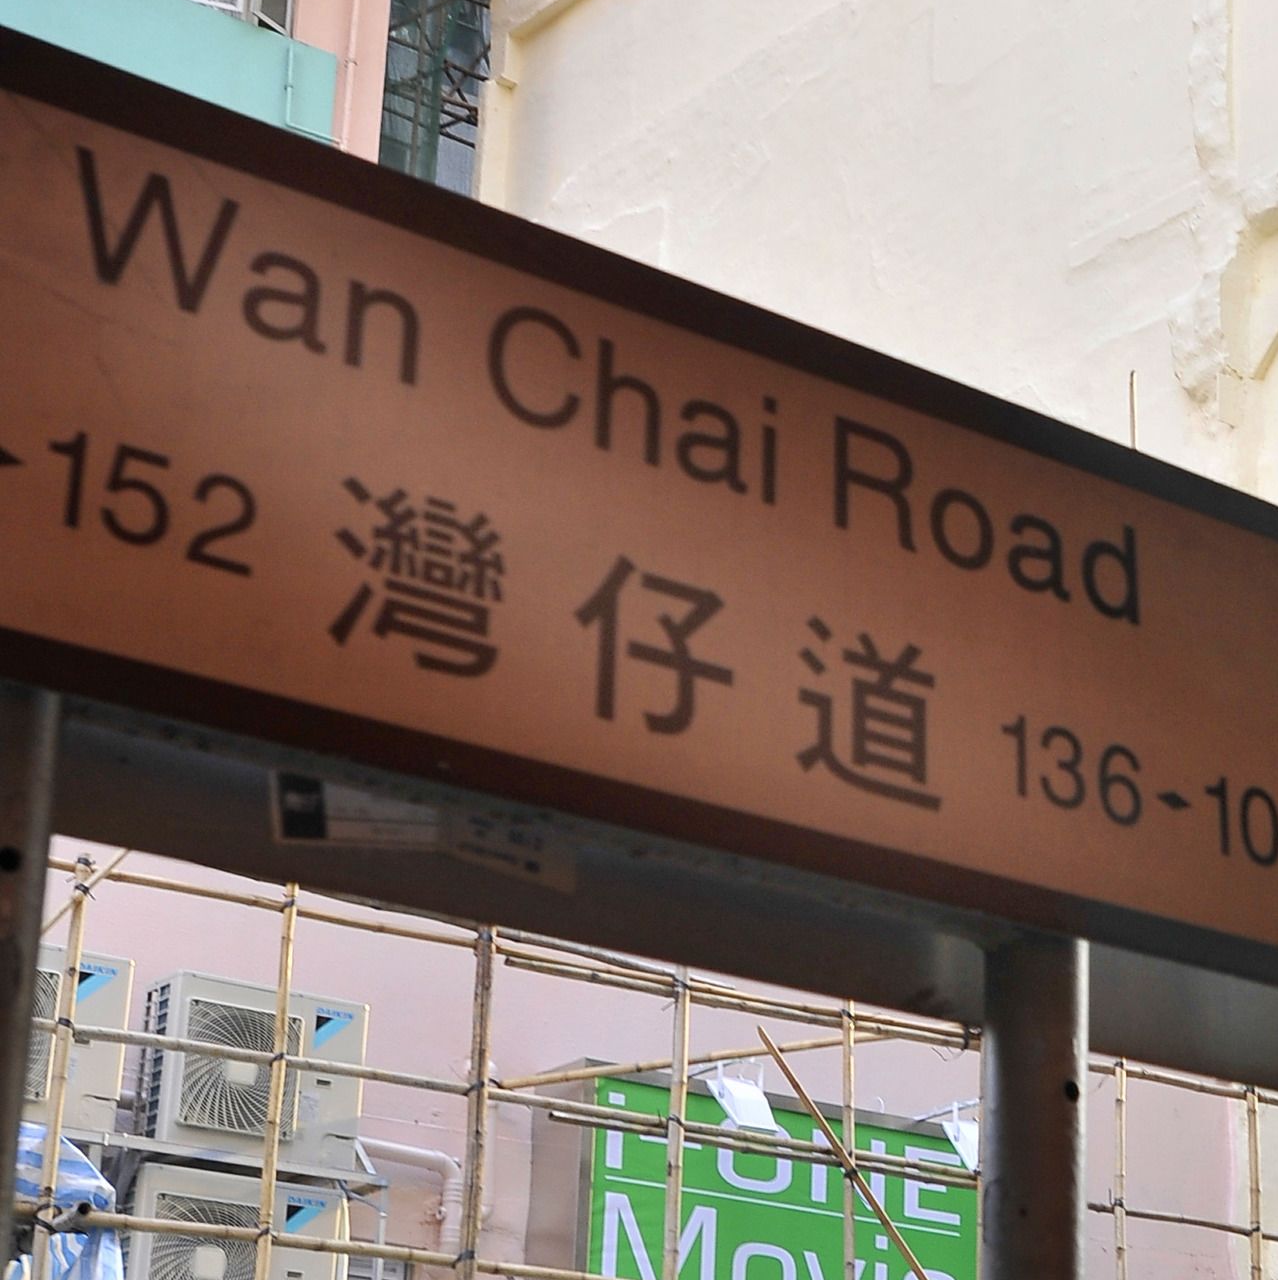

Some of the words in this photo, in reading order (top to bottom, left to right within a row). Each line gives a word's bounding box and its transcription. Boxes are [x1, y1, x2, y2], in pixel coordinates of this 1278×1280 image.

[76, 145, 420, 386] Wan
[488, 305, 780, 507] Chai
[833, 416, 1142, 627] Road
[329, 475, 942, 811] 灣仔道
[316, 1006, 355, 1020] DAIKIN
[287, 1195, 328, 1208] DAIKIN
